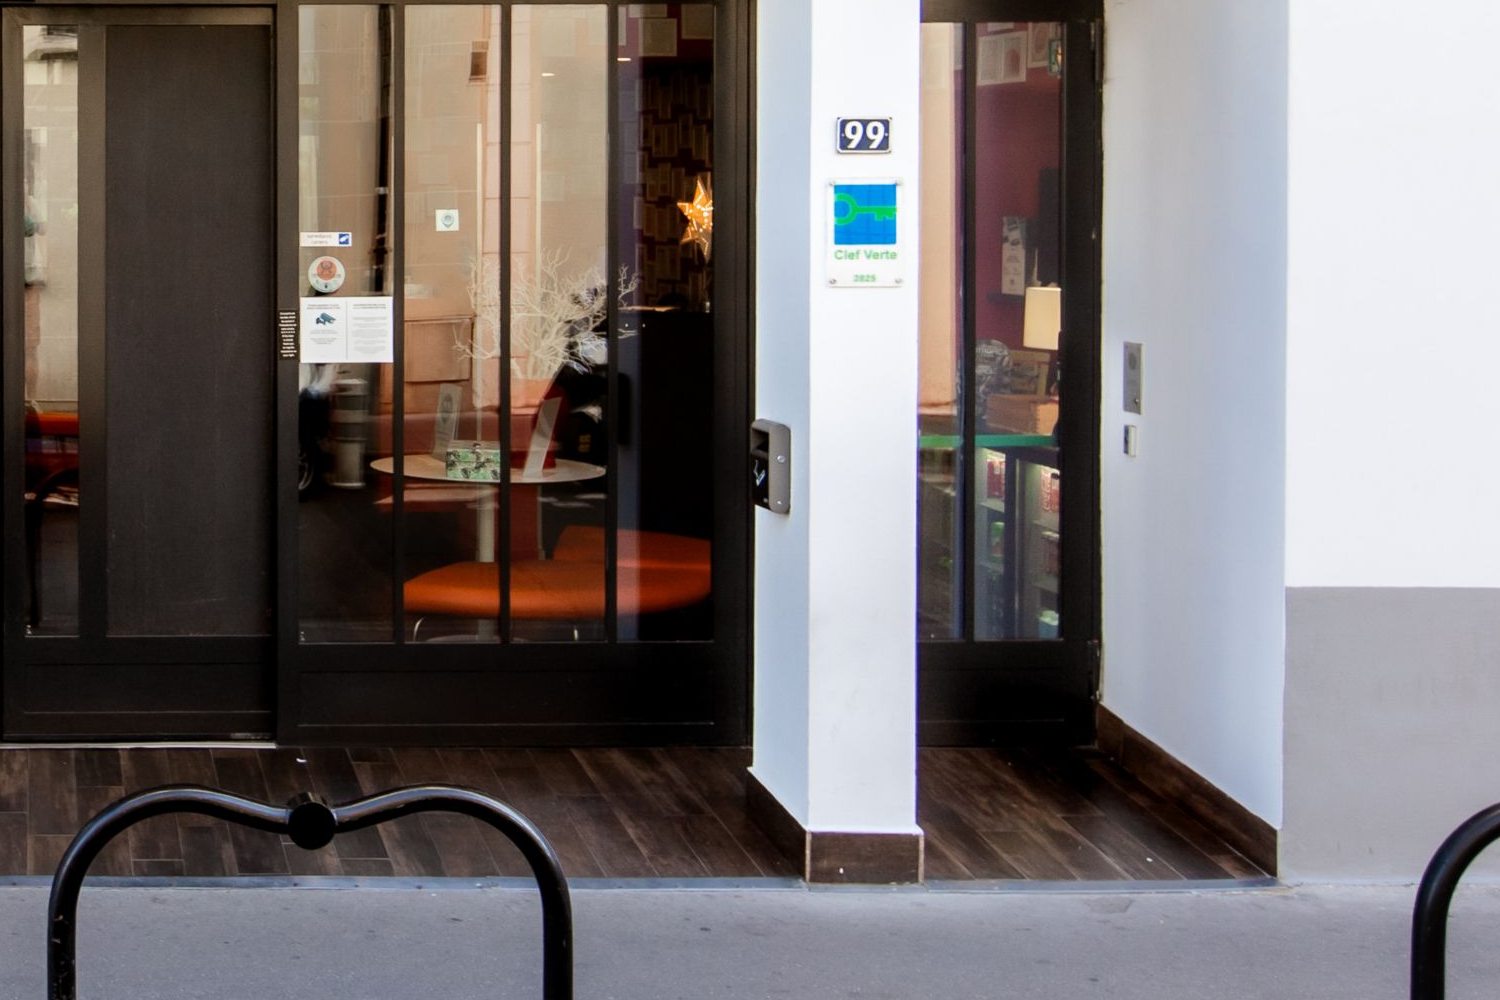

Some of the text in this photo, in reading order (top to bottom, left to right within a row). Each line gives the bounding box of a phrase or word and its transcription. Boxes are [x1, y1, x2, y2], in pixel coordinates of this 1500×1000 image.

[844, 121, 885, 149] 99
[834, 249, 898, 260] Clef Verte
